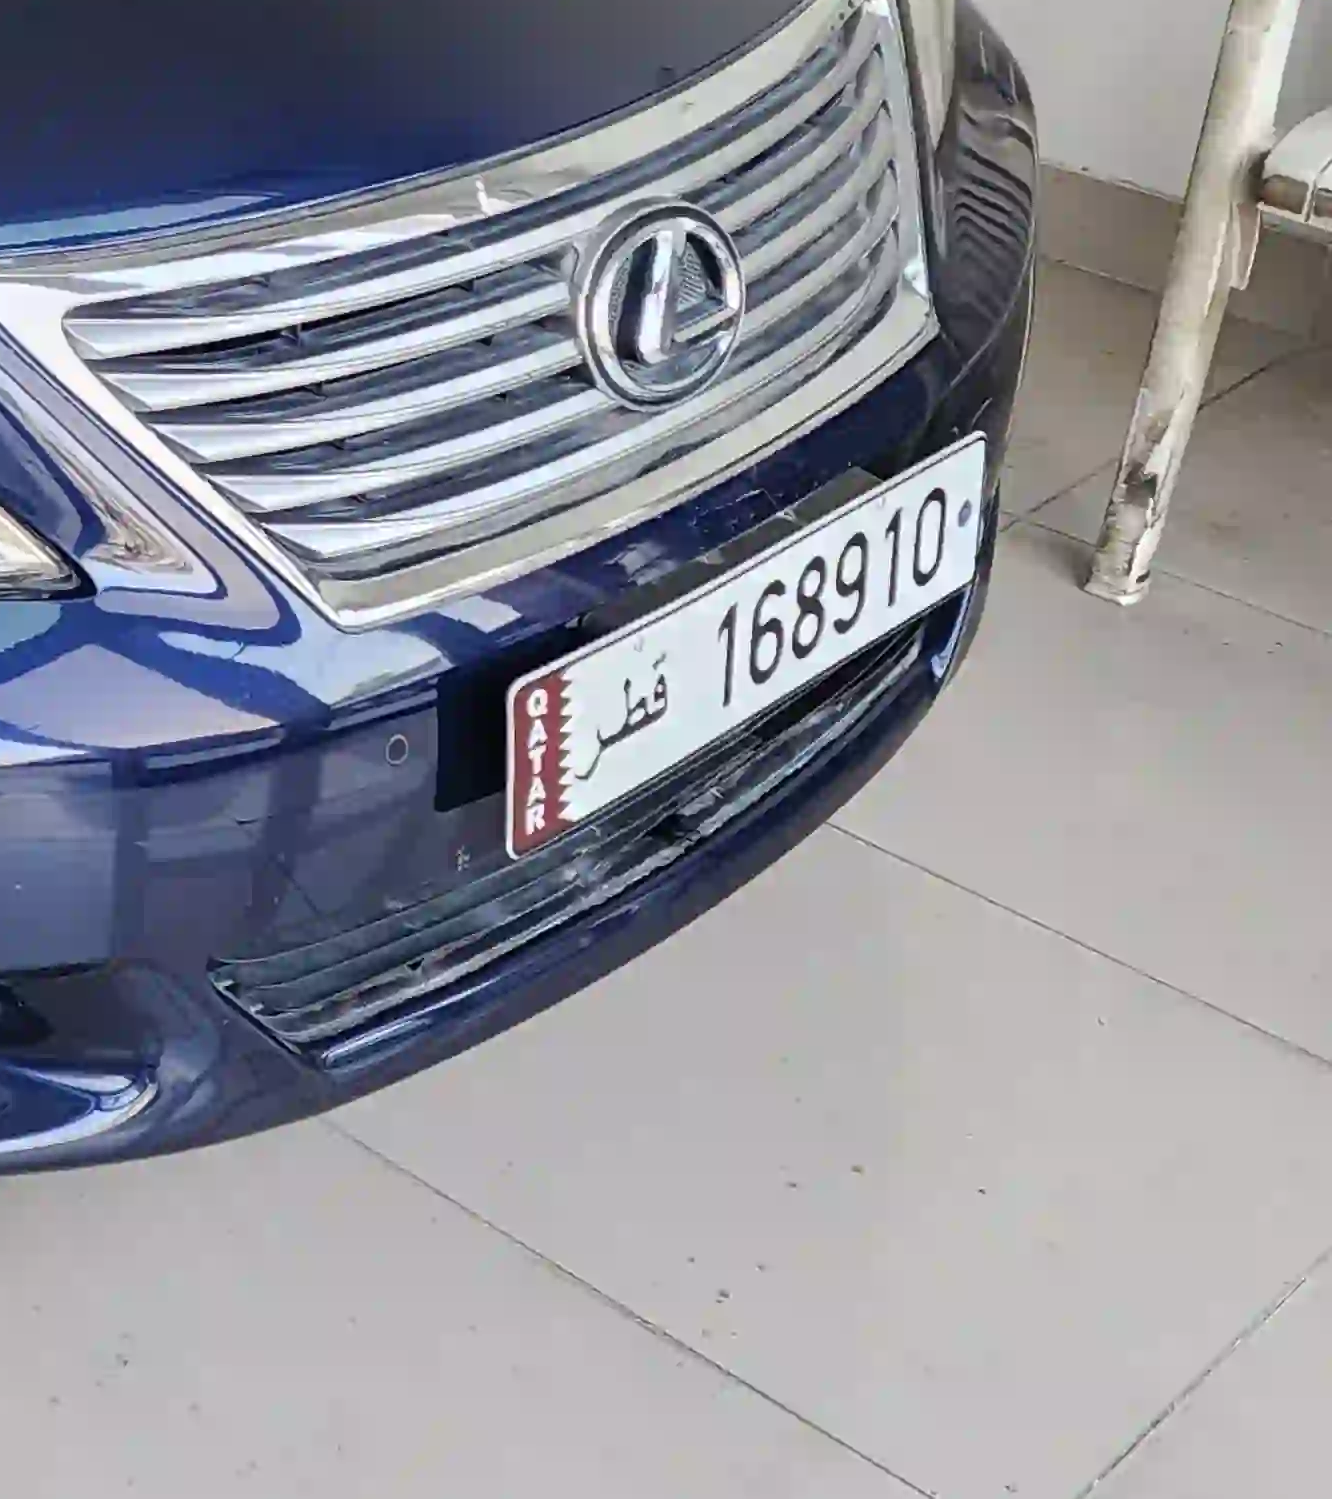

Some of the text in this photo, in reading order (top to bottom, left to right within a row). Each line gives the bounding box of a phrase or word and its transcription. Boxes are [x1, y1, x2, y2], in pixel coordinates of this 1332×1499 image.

[717, 487, 947, 708] 168910
[524, 688, 549, 836] QATAR
[574, 651, 669, 782] قطر
